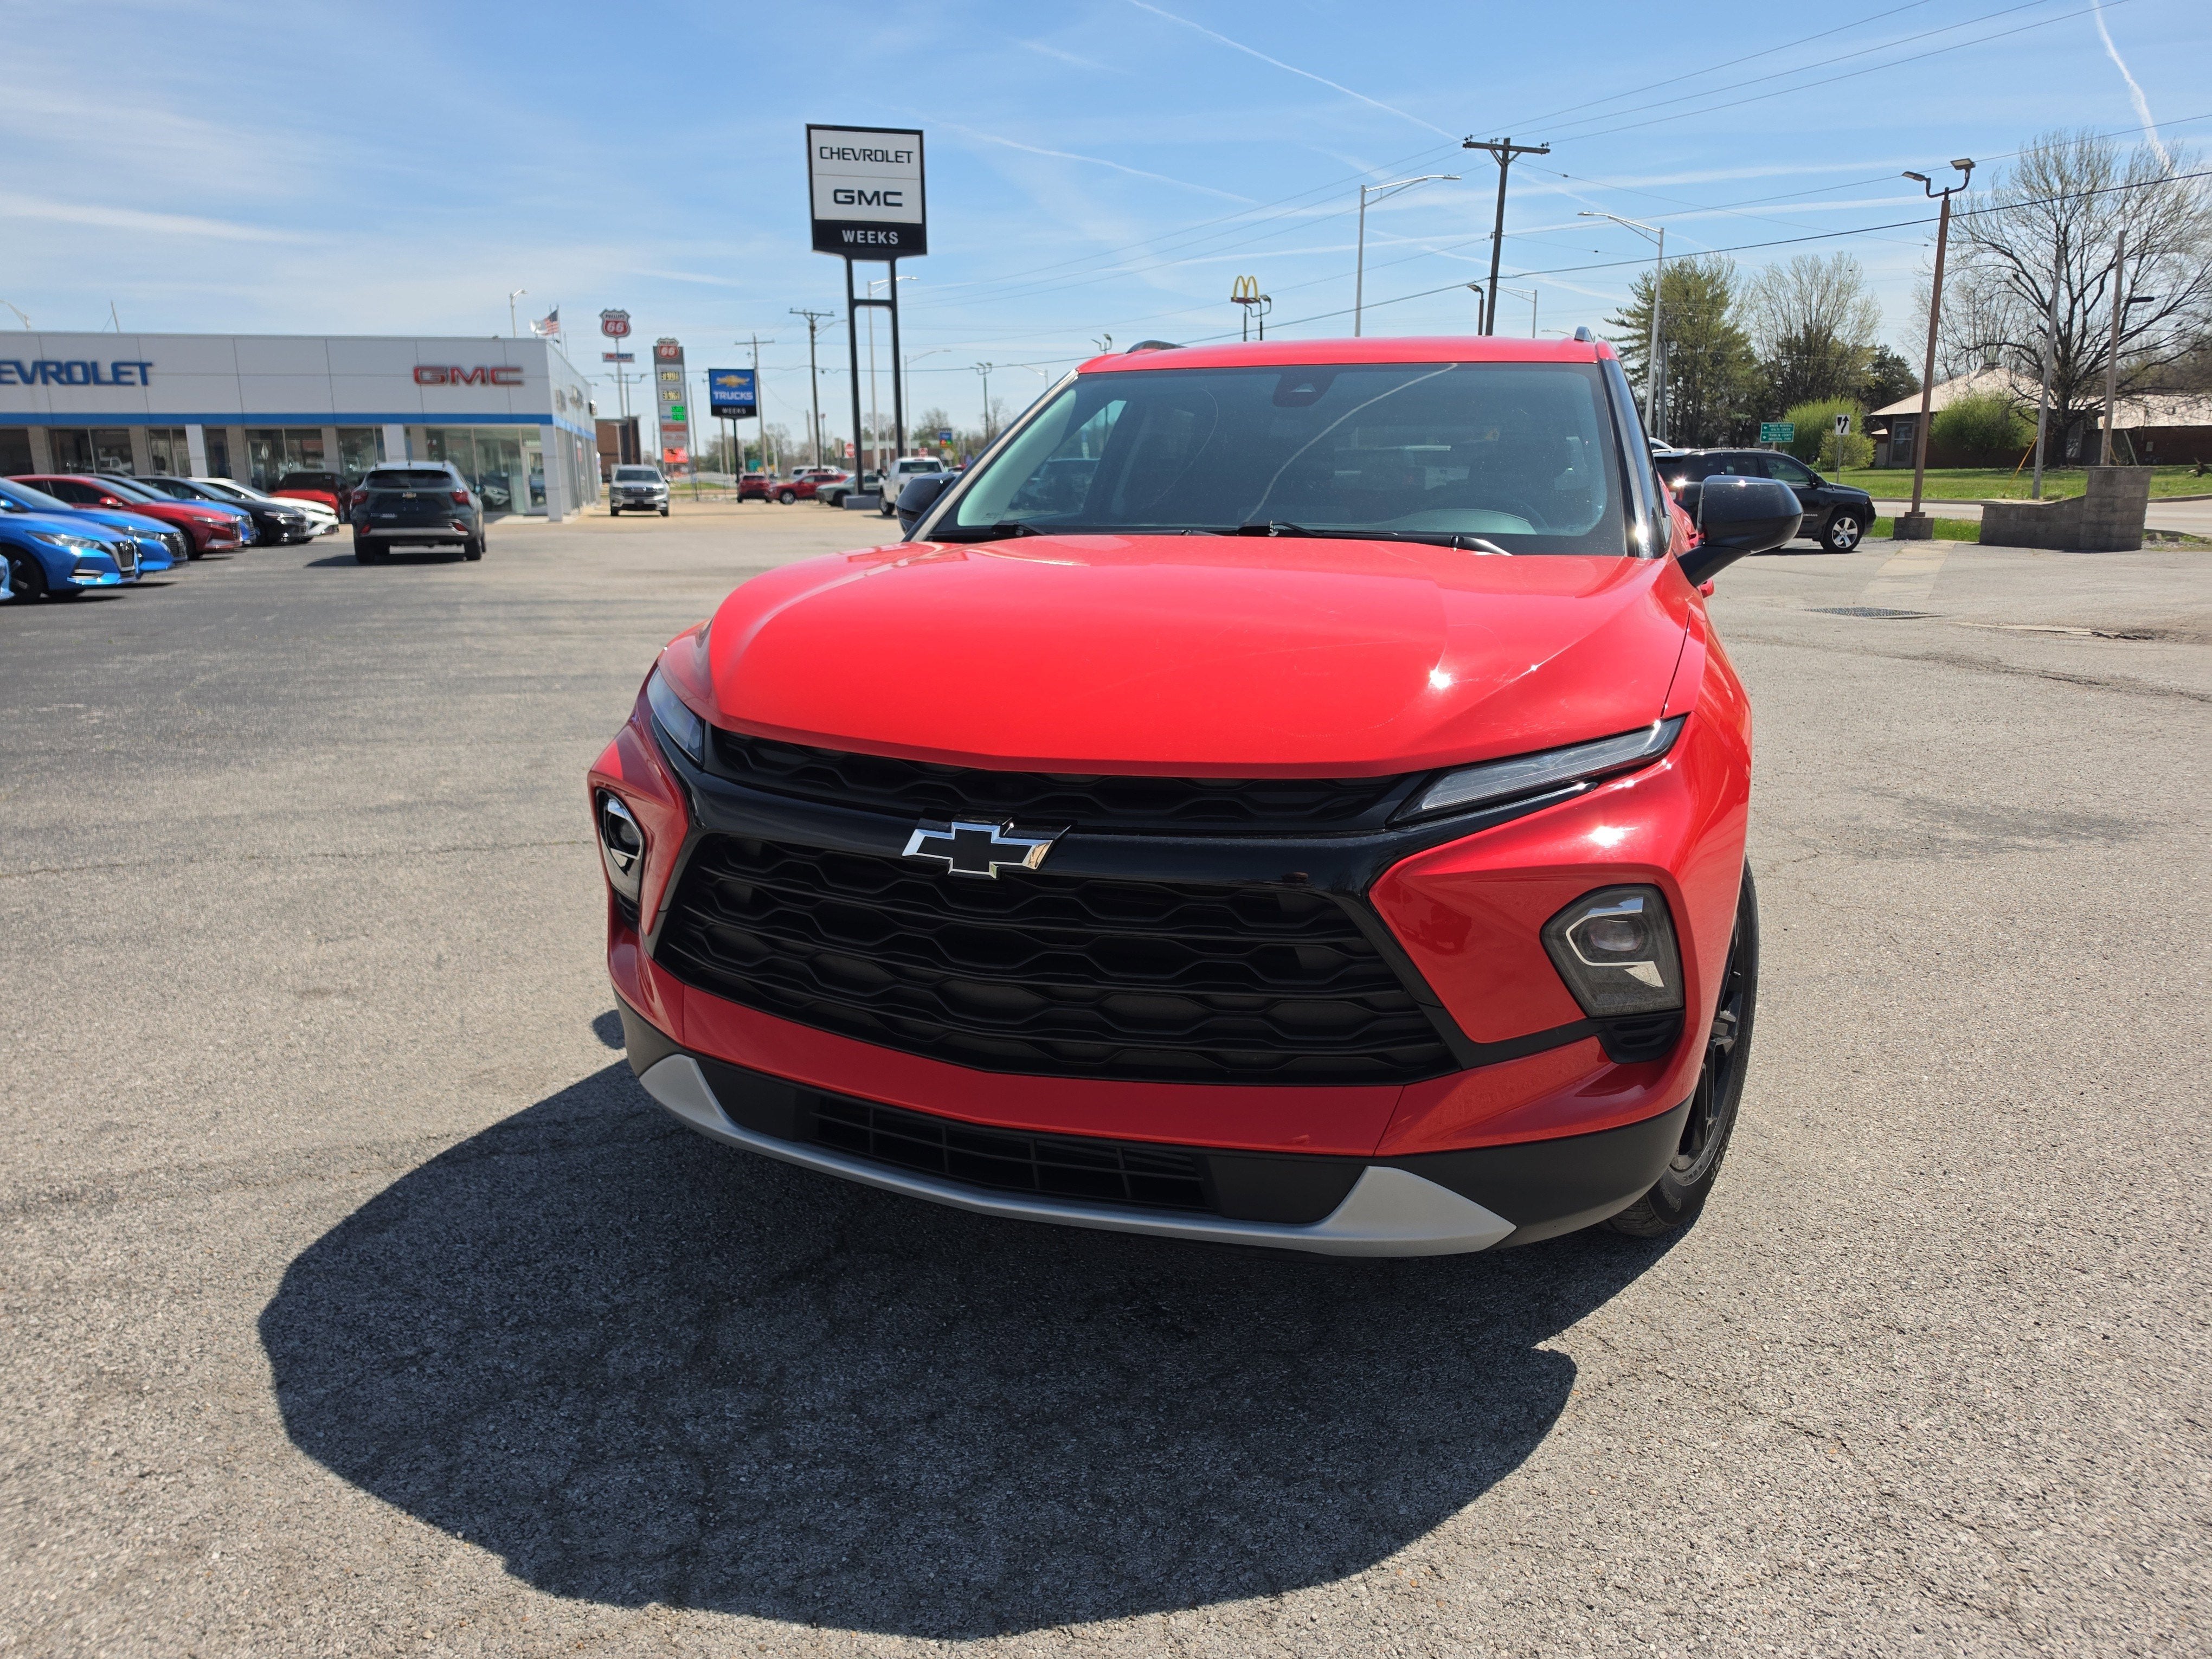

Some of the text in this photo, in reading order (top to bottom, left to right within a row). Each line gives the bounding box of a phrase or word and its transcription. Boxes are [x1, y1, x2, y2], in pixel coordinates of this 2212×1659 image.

[819, 146, 914, 164] CHEVROLET
[833, 188, 903, 207] GMC
[841, 229, 899, 245] WEEKS
[607, 321, 625, 333] 66
[660, 346, 676, 356] 66
[413, 365, 523, 385] GMC
[712, 390, 754, 400] TRUCKS
